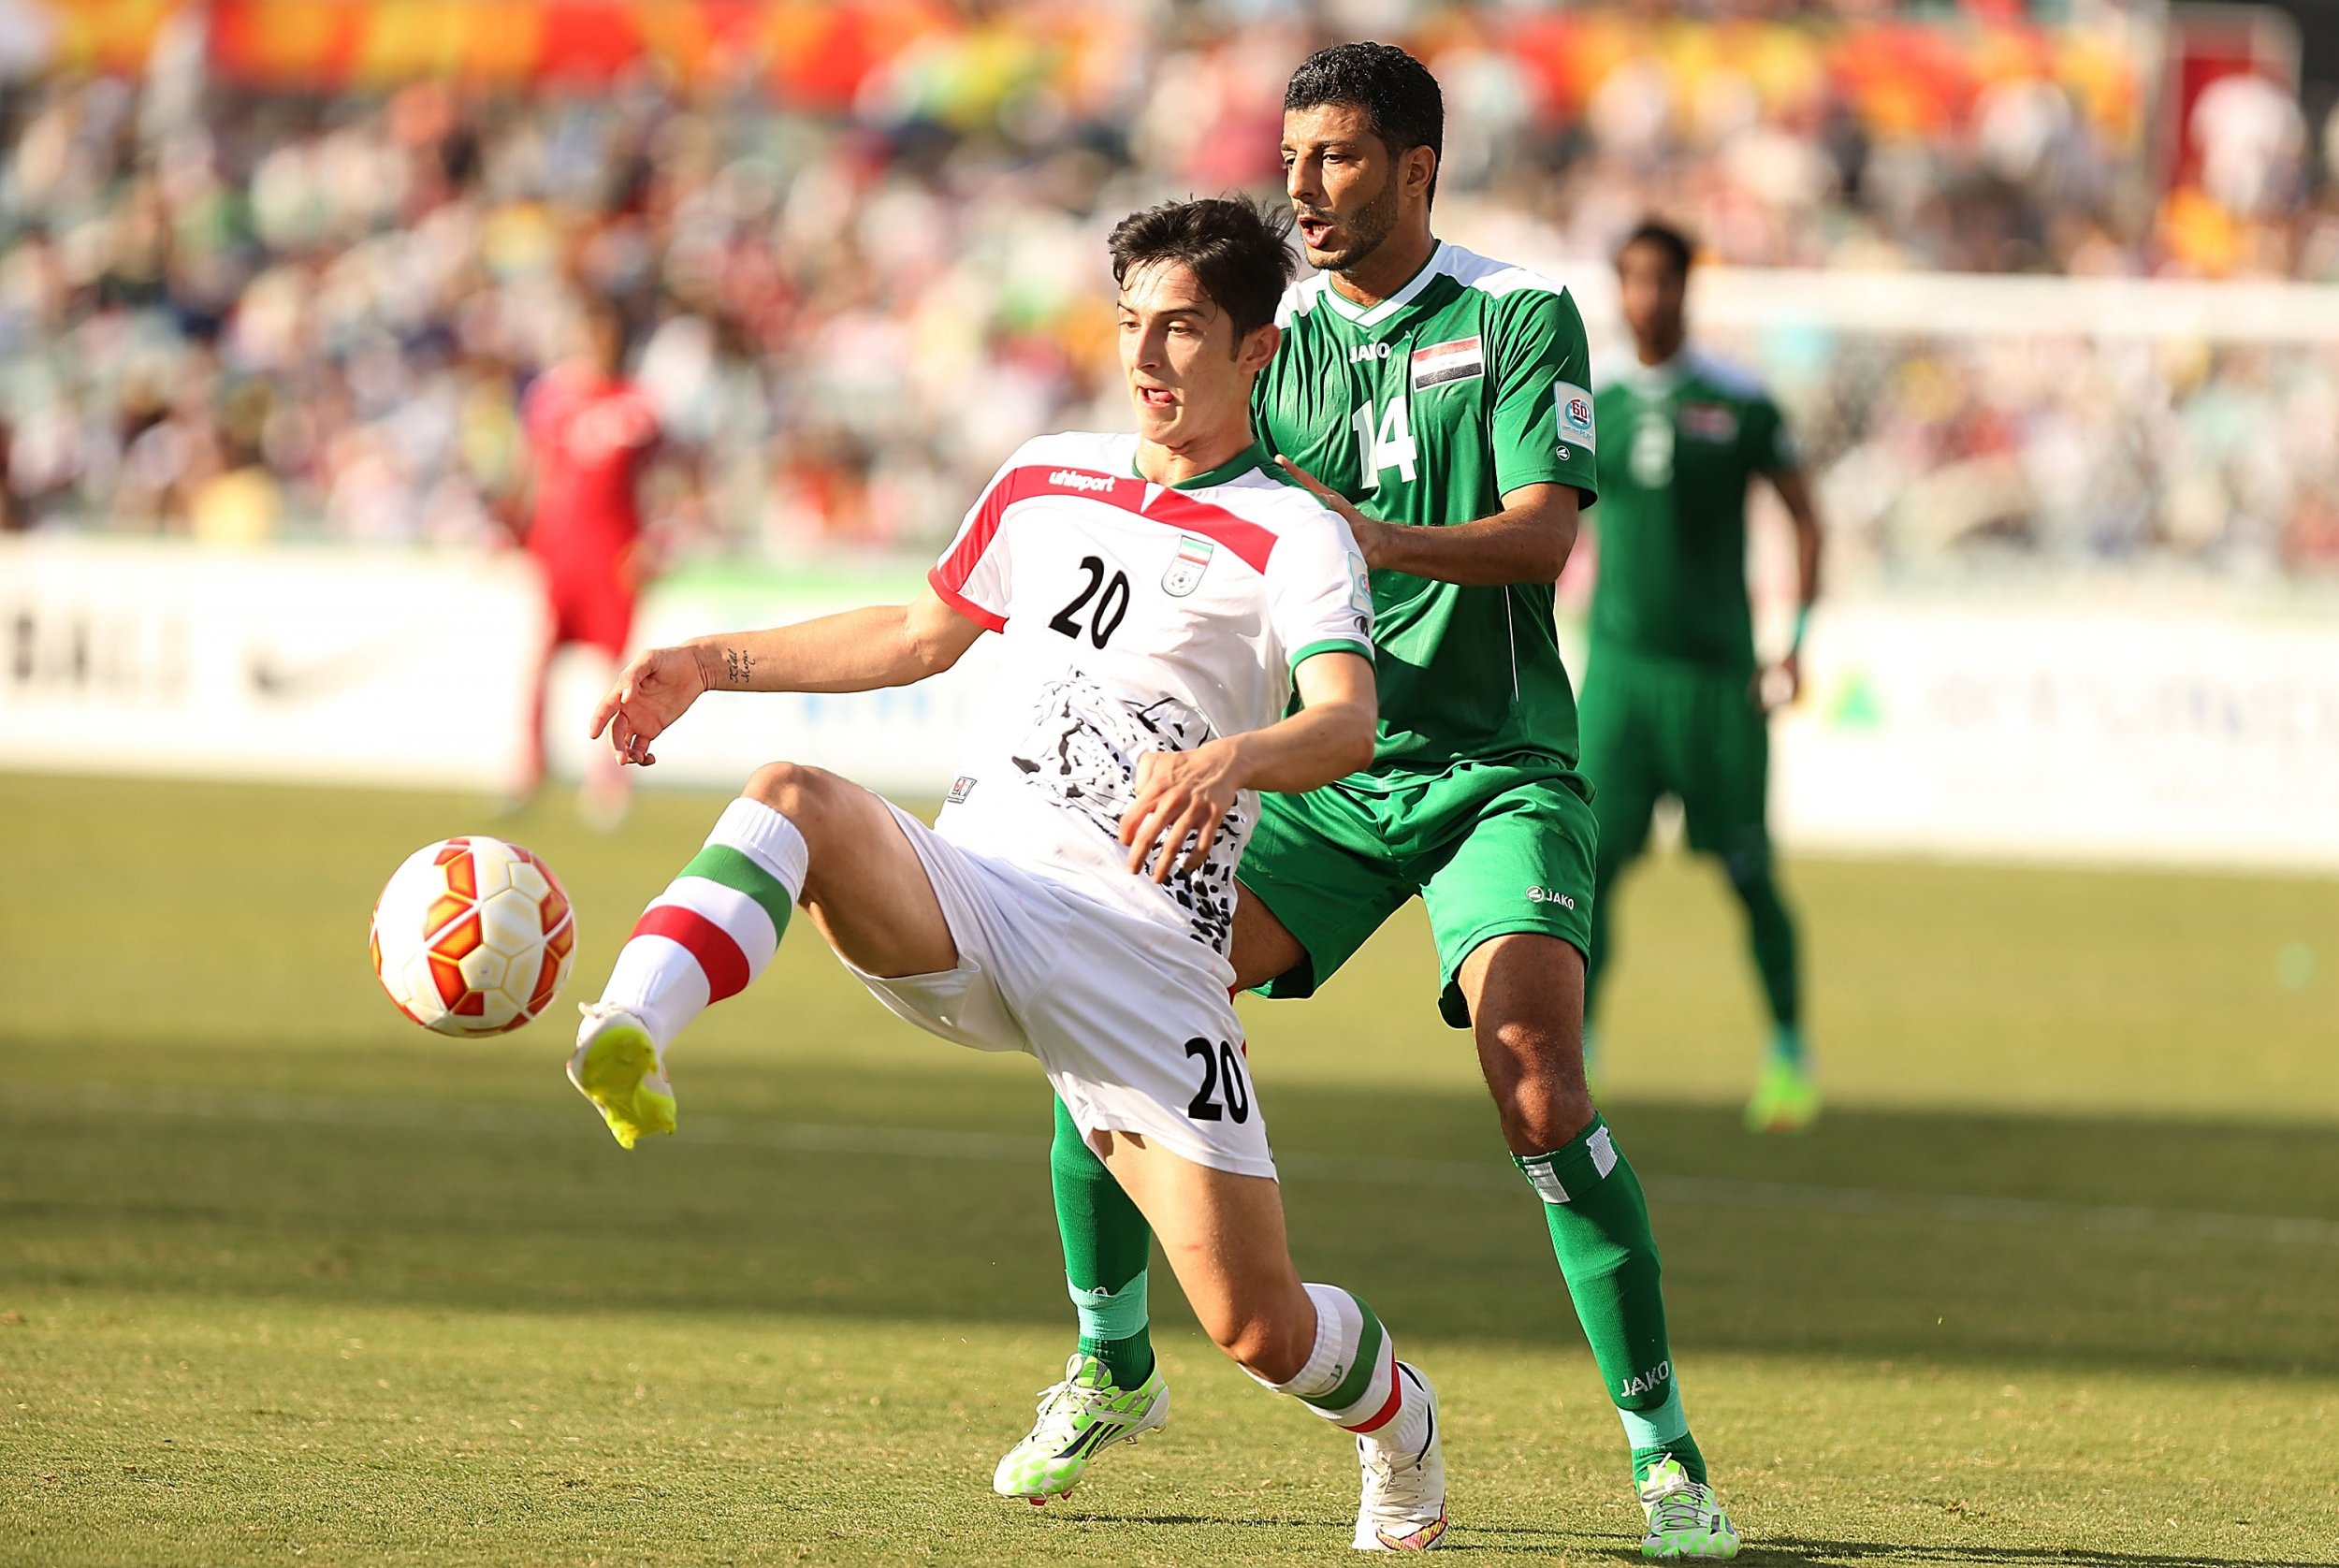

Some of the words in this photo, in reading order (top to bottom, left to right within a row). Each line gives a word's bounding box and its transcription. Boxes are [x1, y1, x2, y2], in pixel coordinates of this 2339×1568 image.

[1351, 395, 1418, 489] 14
[1048, 469, 1116, 492] uhlsport
[1048, 555, 1130, 649] 20
[1546, 889, 1575, 910] JAKO
[1184, 1037, 1249, 1125] 20
[1620, 1360, 1669, 1398] JAKO
